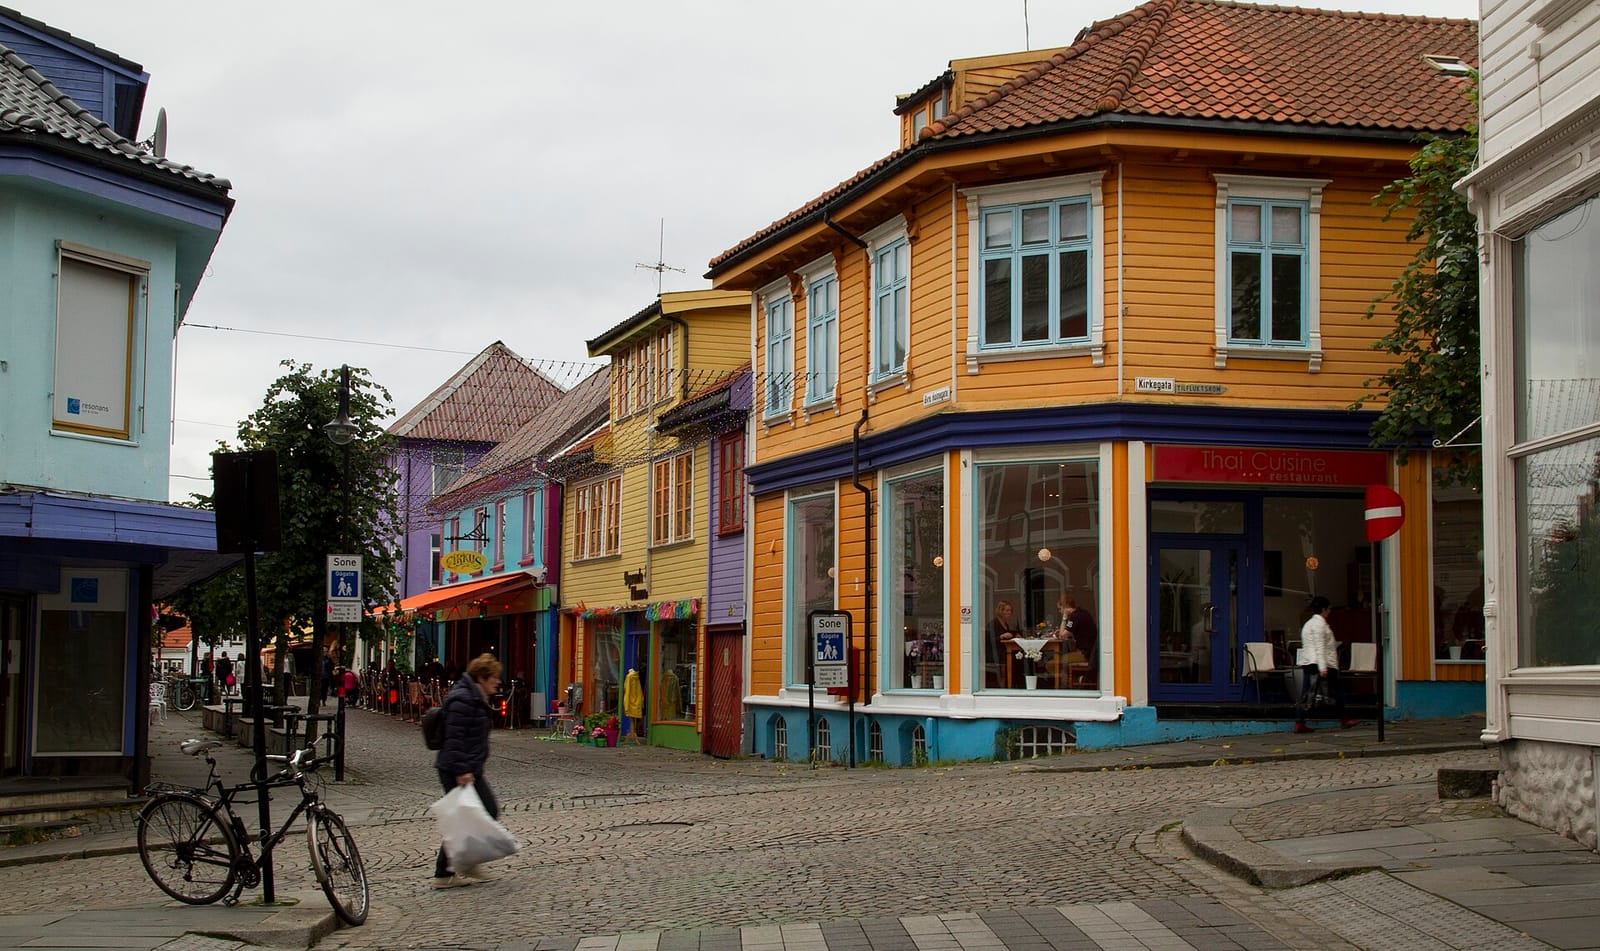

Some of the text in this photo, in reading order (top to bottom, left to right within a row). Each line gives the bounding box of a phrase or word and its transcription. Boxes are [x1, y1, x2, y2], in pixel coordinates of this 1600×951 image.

[1138, 379, 1172, 391] Kirkegata
[81, 403, 109, 412] resonans
[1201, 451, 1327, 472] Thai Cuisine
[1269, 472, 1339, 484] restaurant
[333, 557, 357, 567] Sone
[818, 619, 842, 628] Sone
